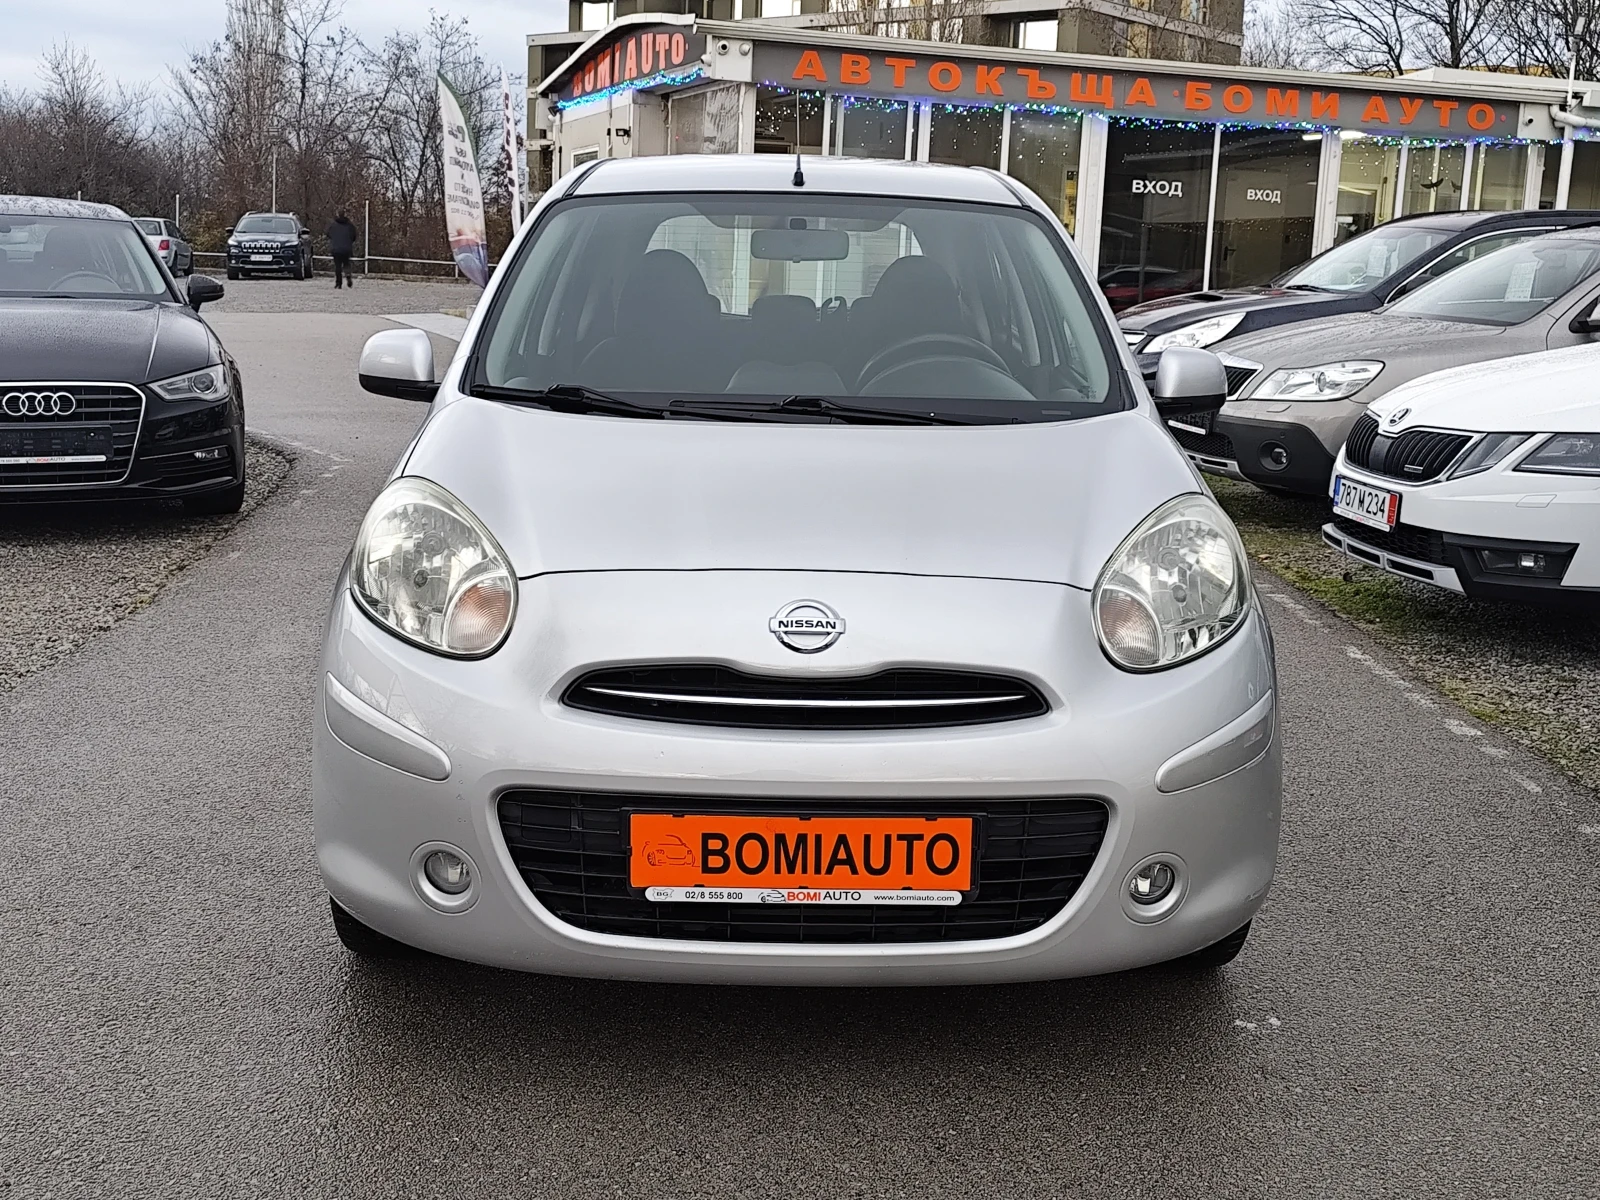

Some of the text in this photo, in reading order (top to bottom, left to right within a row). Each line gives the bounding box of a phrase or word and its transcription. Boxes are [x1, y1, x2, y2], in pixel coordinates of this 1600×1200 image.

[792, 50, 1495, 130] АВТОКЪЩА БОМИ АУТО
[1131, 179, 1184, 197] ВХОД
[1246, 188, 1281, 204] ВХОД
[778, 620, 836, 629] NISSAN
[700, 832, 959, 875] BOMIAUTO
[787, 892, 821, 902] BOMI
[823, 891, 862, 901] AUTO
[874, 894, 955, 902] www.bomiauto.com
